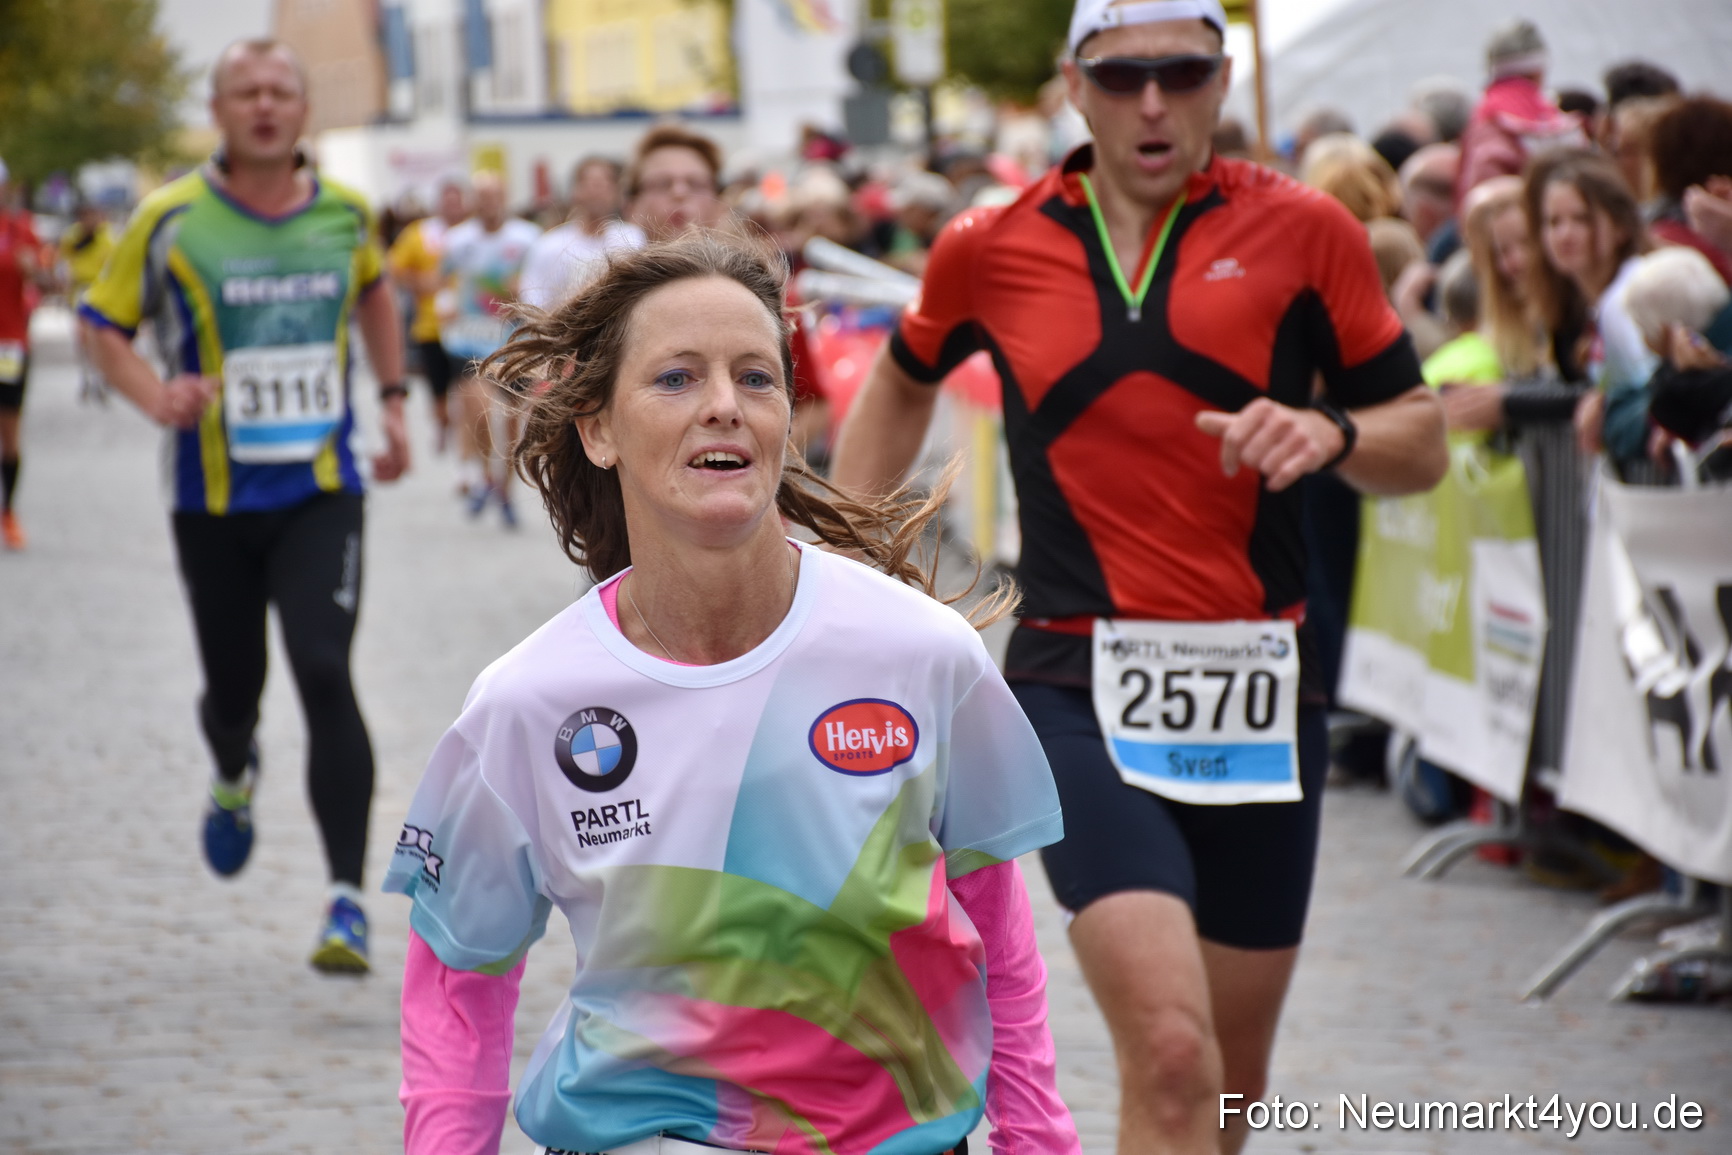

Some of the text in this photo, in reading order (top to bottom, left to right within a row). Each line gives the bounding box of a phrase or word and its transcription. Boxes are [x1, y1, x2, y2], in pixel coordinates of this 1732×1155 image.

[239, 376, 331, 417] 3116
[1172, 639, 1263, 661] Neumarkt
[1120, 669, 1279, 732] 2570
[558, 709, 628, 743] BMW
[825, 721, 909, 755] Hervis
[834, 751, 874, 761] SPORTS
[1167, 751, 1230, 778] Sven
[571, 799, 650, 832] PARTL
[577, 821, 652, 849] Neumarkt
